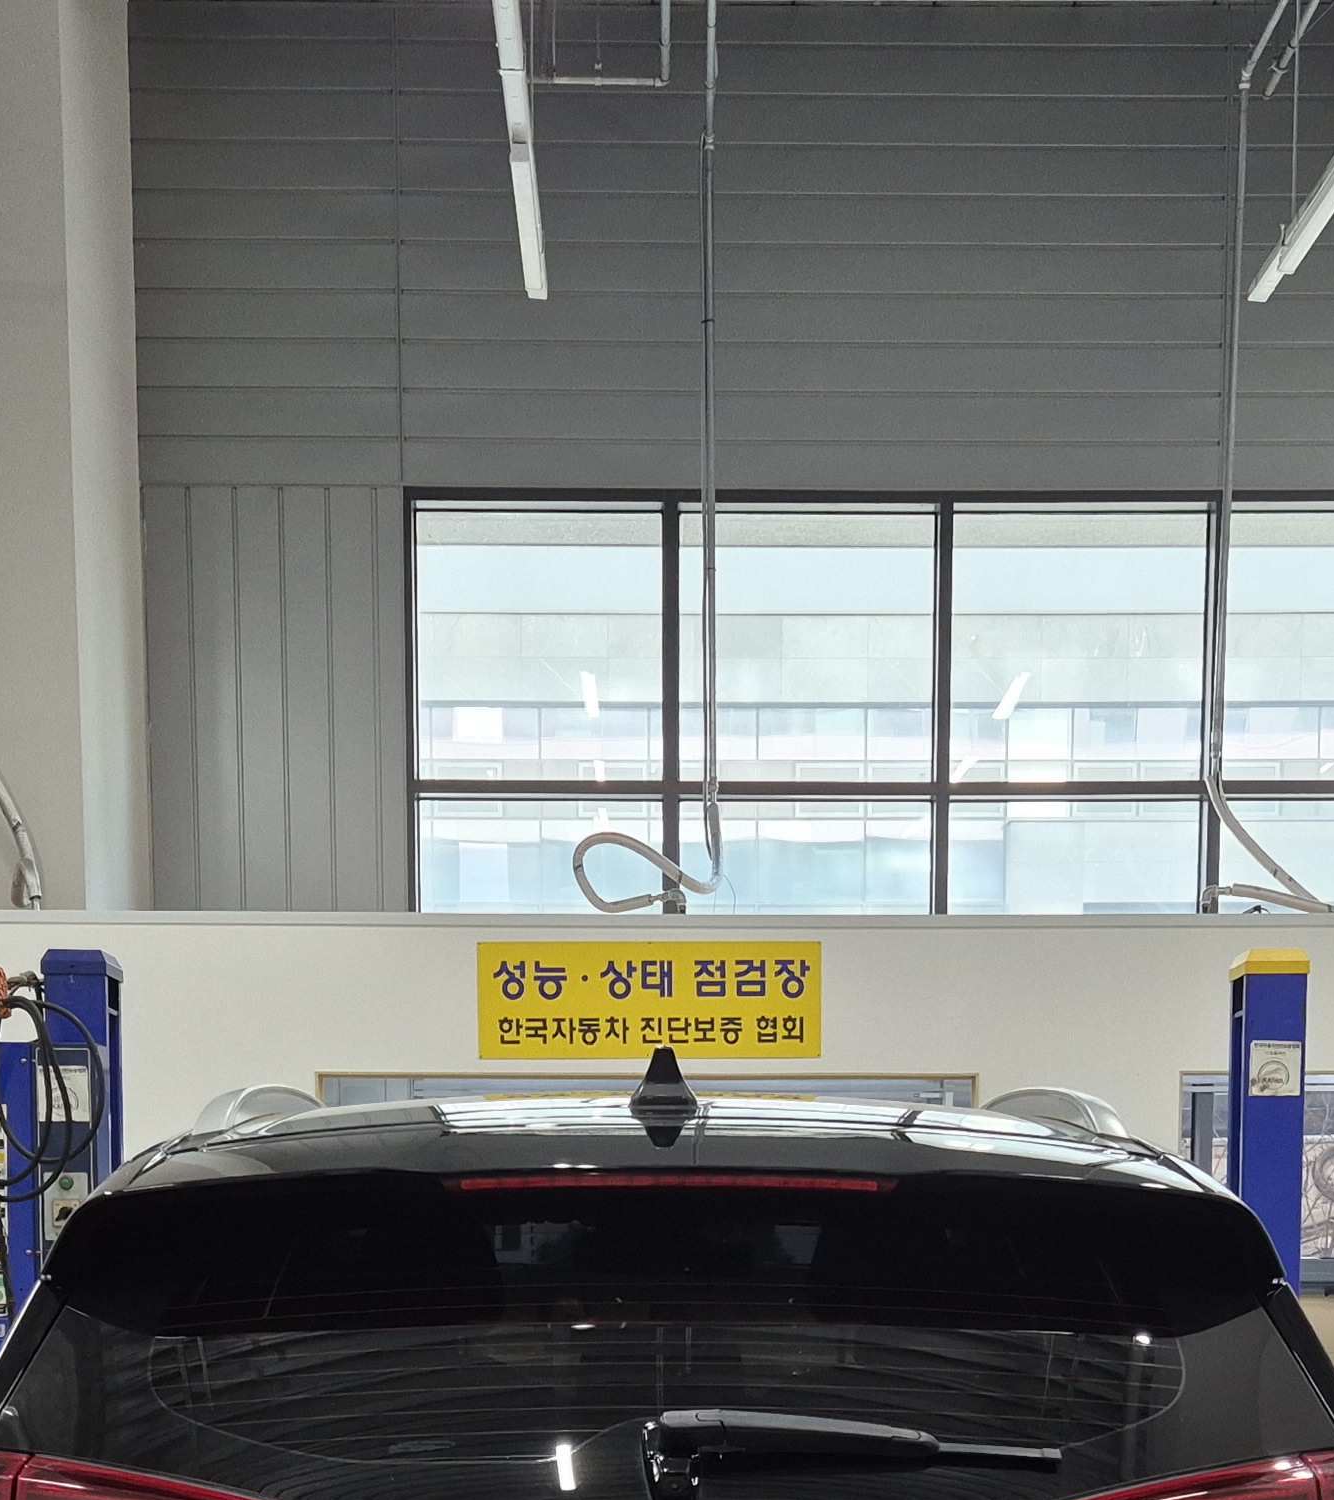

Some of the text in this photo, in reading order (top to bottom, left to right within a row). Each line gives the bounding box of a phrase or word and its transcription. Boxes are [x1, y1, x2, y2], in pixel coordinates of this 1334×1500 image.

[694, 959, 811, 998] 점검장
[498, 1015, 804, 1045] 한국자동차 진단보증 협회
